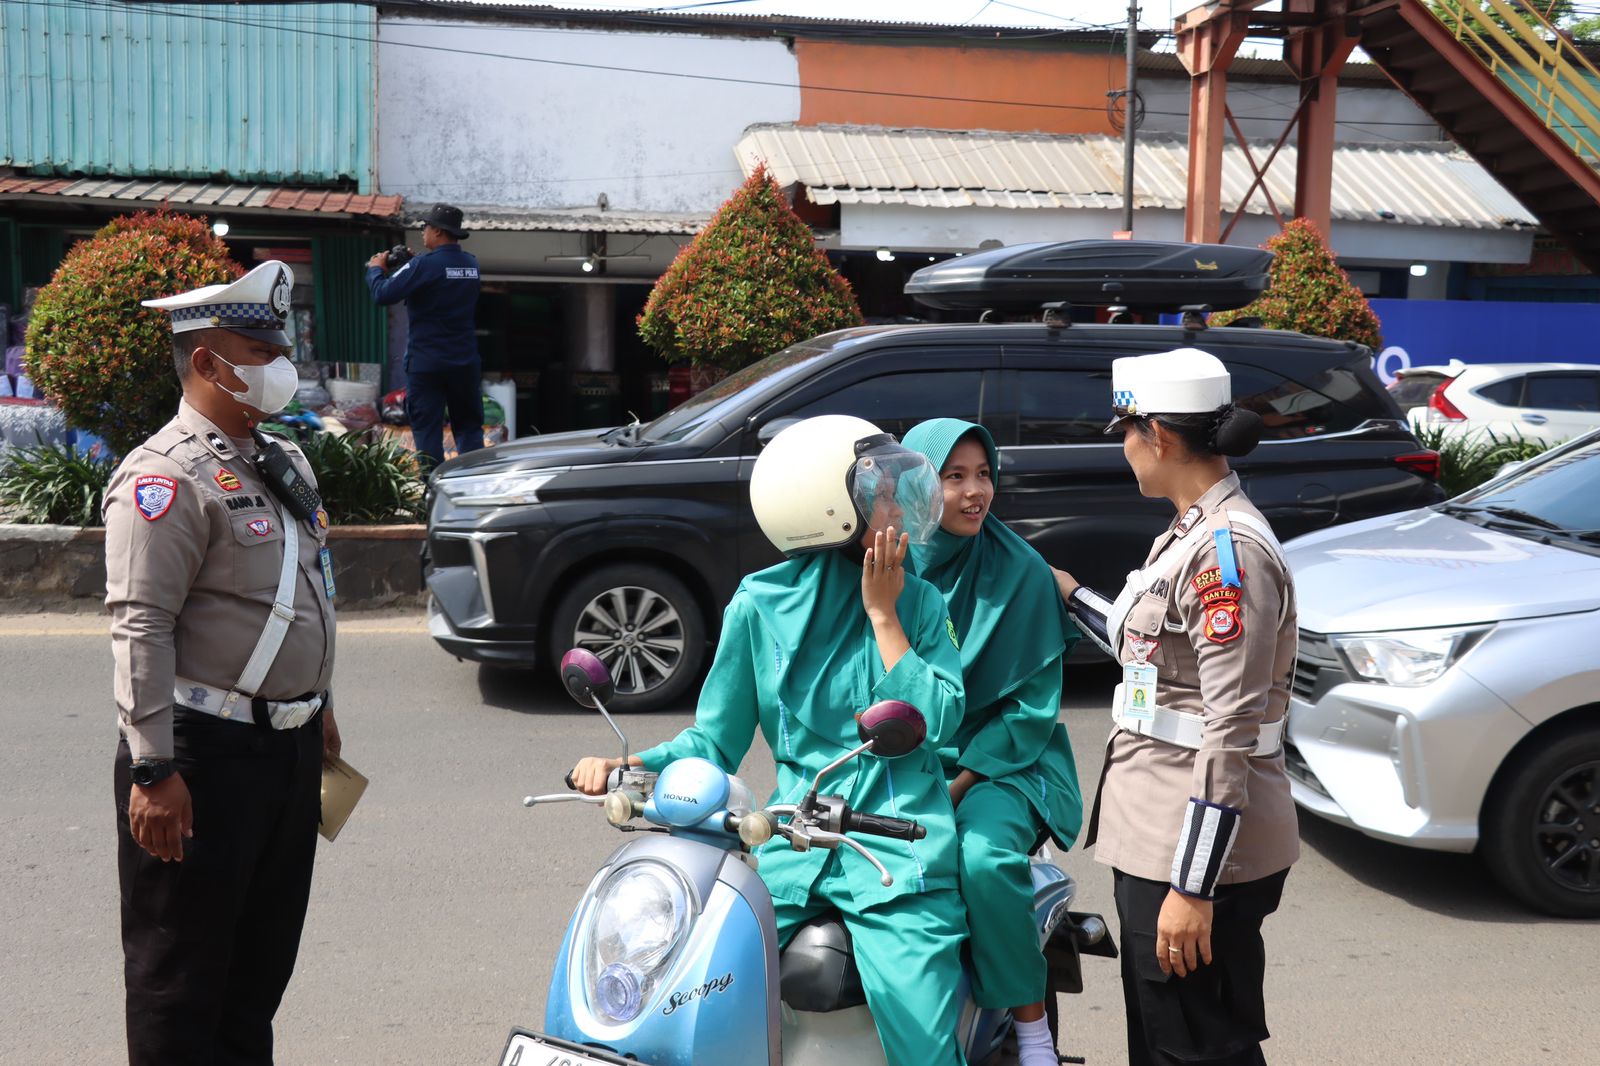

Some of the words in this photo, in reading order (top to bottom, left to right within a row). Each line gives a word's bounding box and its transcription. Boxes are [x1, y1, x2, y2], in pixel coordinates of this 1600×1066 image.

[153, 477, 174, 487] LINTAS
[1204, 590, 1236, 601] BANTEN
[663, 793, 698, 805] HONDA
[662, 973, 734, 1015] Scoopy
